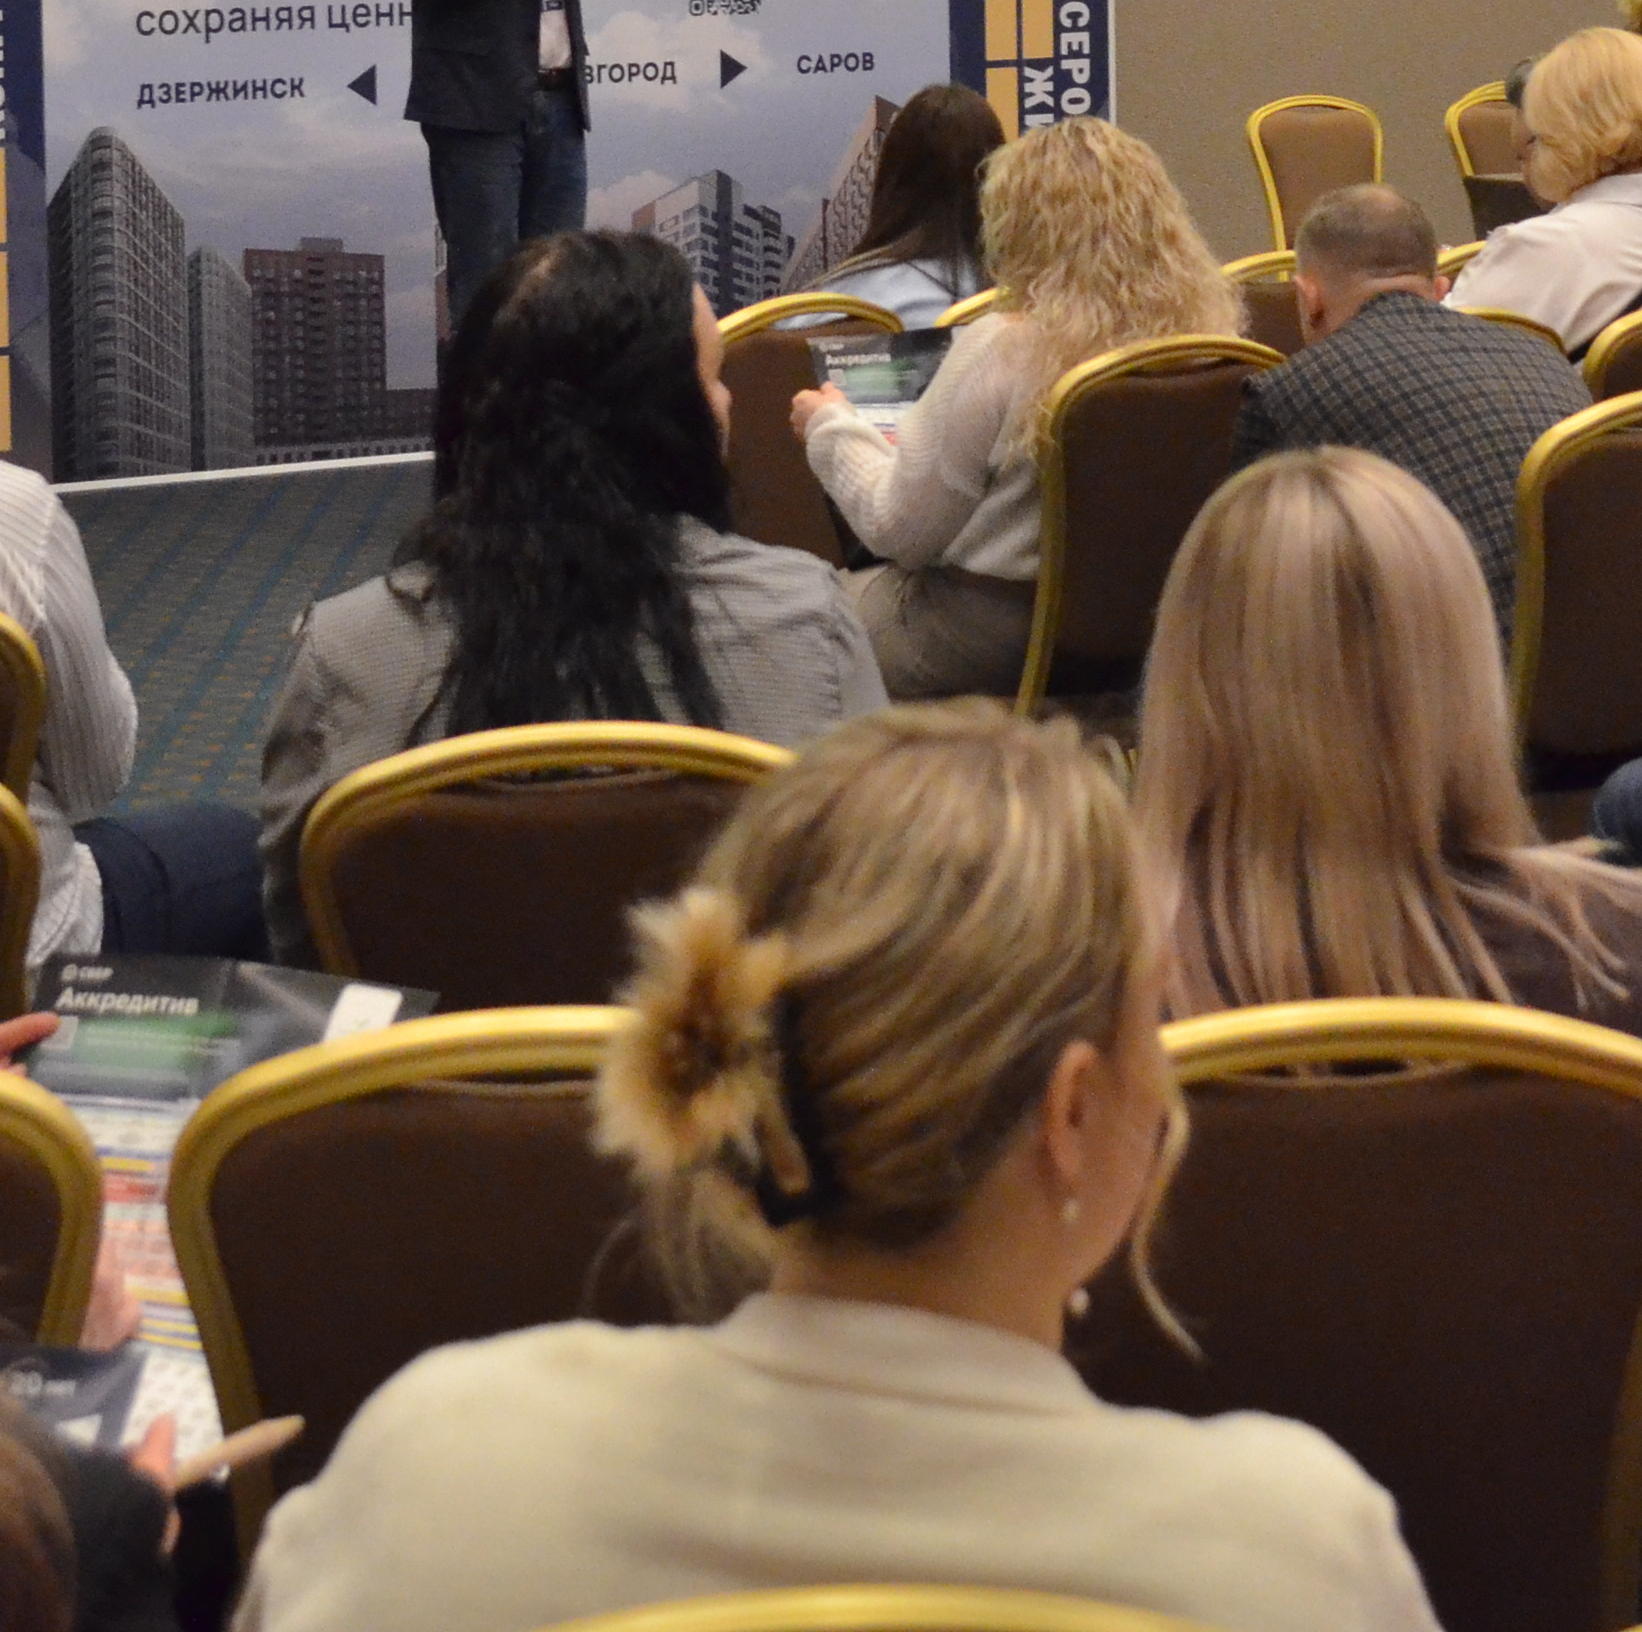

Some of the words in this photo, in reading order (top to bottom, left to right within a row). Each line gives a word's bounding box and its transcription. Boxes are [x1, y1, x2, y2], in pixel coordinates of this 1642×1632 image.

[135, 5, 316, 44] сохраняя
[137, 77, 306, 110] ДЗЕРЖИНСК
[583, 60, 677, 86] ВГОРОД
[796, 51, 875, 75] САРОВ
